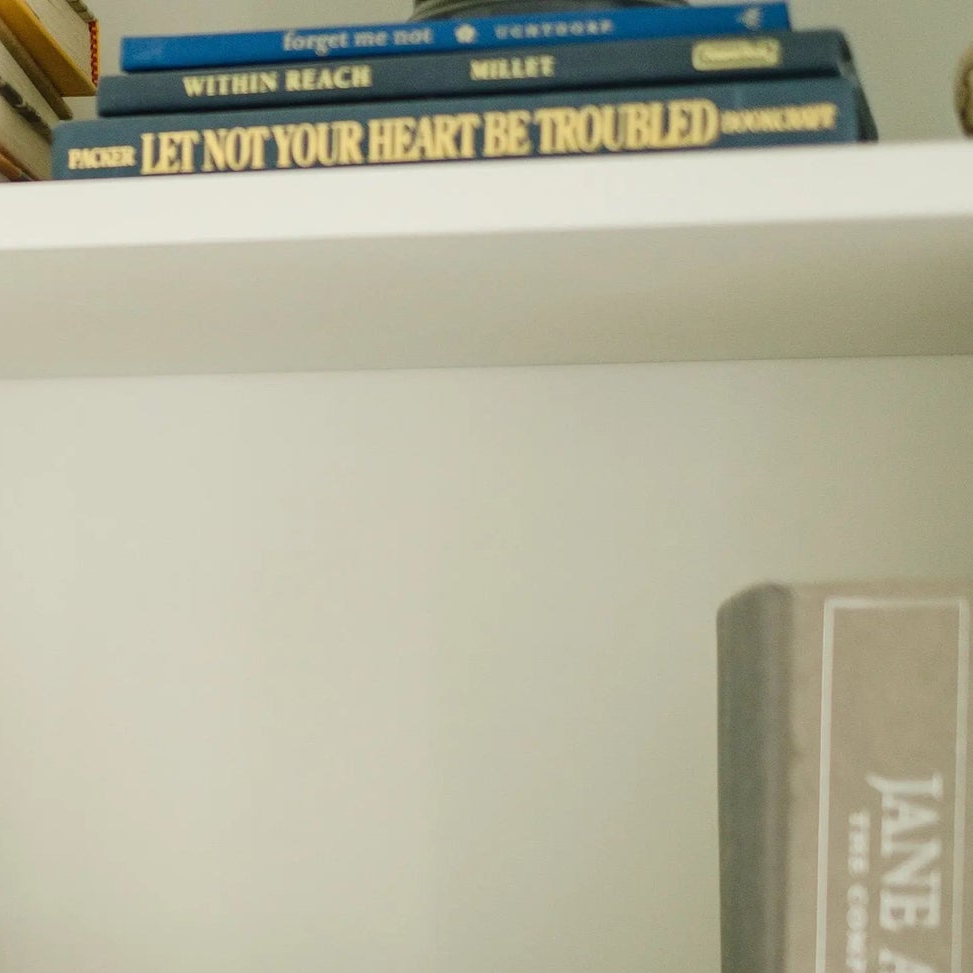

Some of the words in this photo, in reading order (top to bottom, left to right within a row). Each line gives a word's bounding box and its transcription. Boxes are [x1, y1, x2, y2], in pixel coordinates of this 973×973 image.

[283, 30, 348, 56] forget
[354, 31, 388, 47] me
[393, 28, 433, 45] not
[183, 70, 278, 98] WITHIN
[284, 64, 373, 92] REACH
[469, 55, 555, 81] MILLET
[68, 146, 137, 170] PACKER
[140, 129, 200, 175] LET
[200, 125, 274, 172] NOT
[270, 119, 364, 169] YOUR
[367, 112, 481, 164] HEART
[481, 108, 534, 158] BE
[534, 98, 721, 155] TROUBLED
[865, 772, 943, 932] JANE
